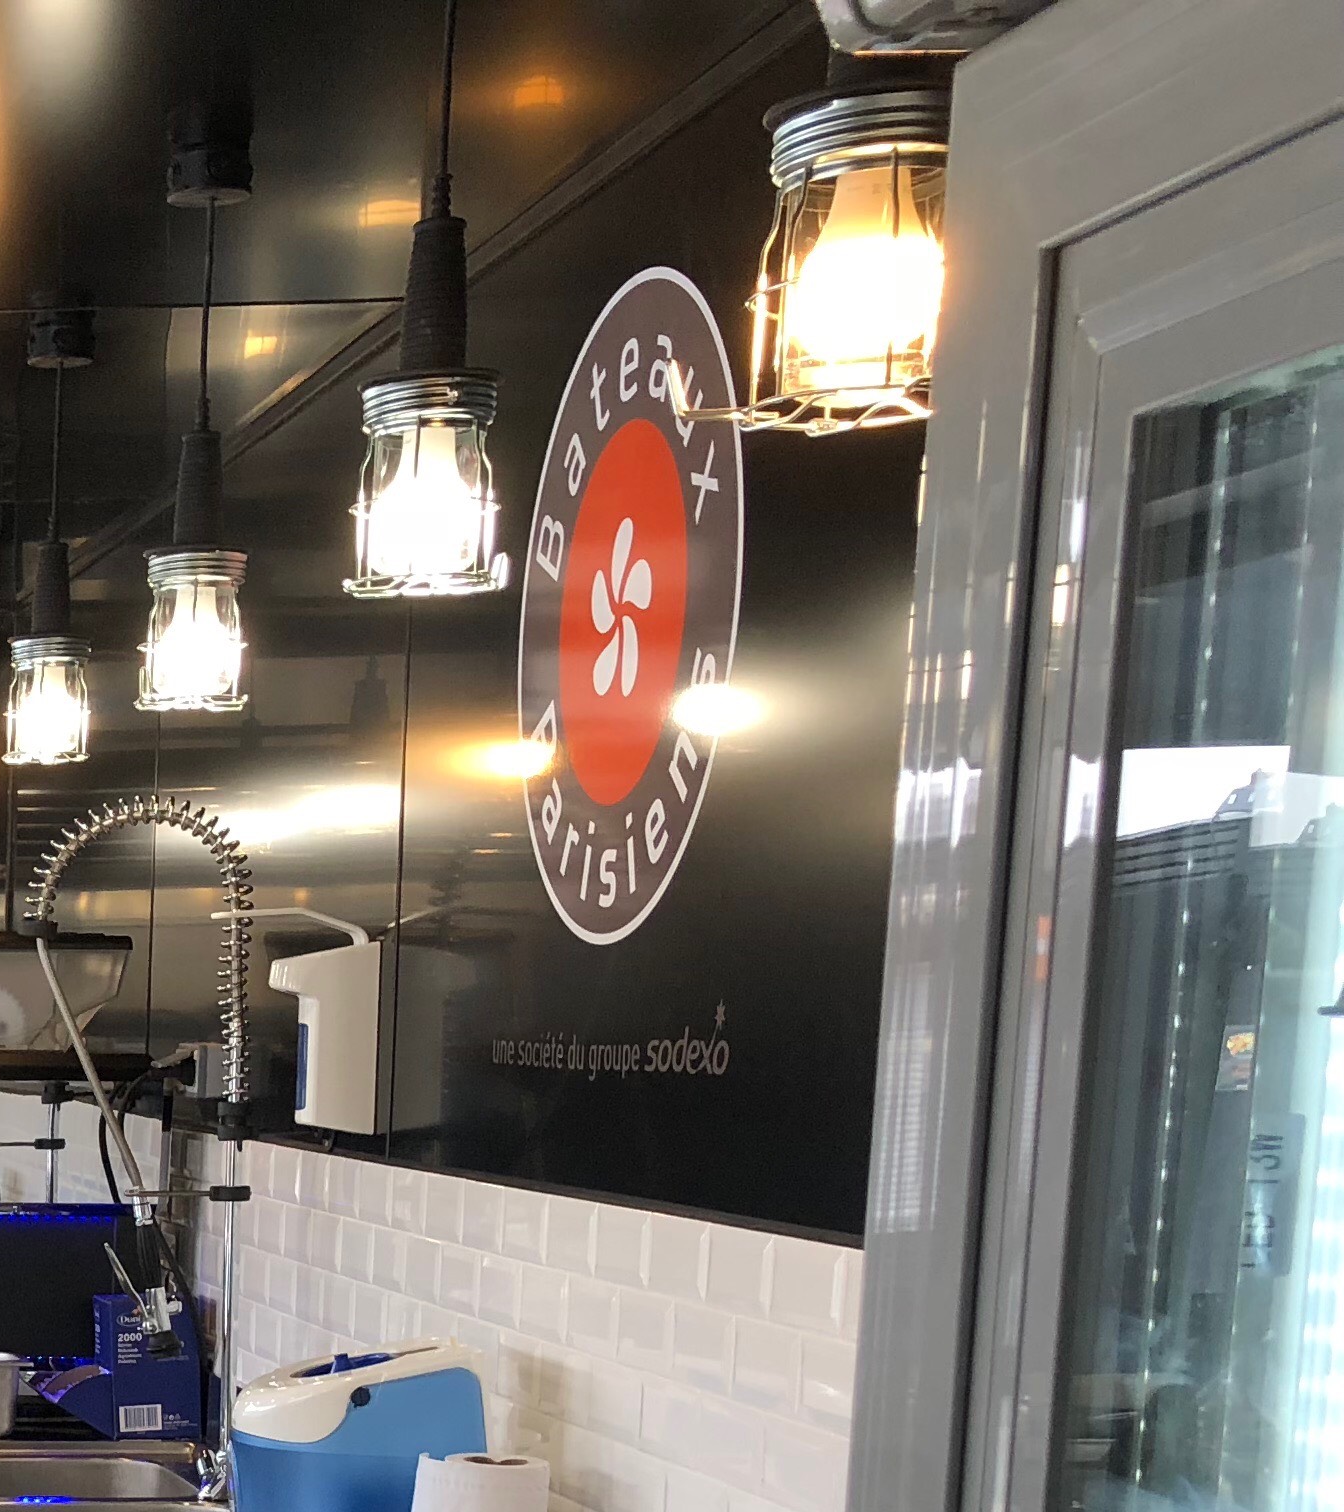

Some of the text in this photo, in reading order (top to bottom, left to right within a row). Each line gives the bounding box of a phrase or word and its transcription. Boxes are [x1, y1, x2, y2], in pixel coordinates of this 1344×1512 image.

[537, 335, 719, 582] Bateaux
[492, 1024, 729, 1081] une société du groupe sodexo
[118, 1332, 142, 1342] 2000
